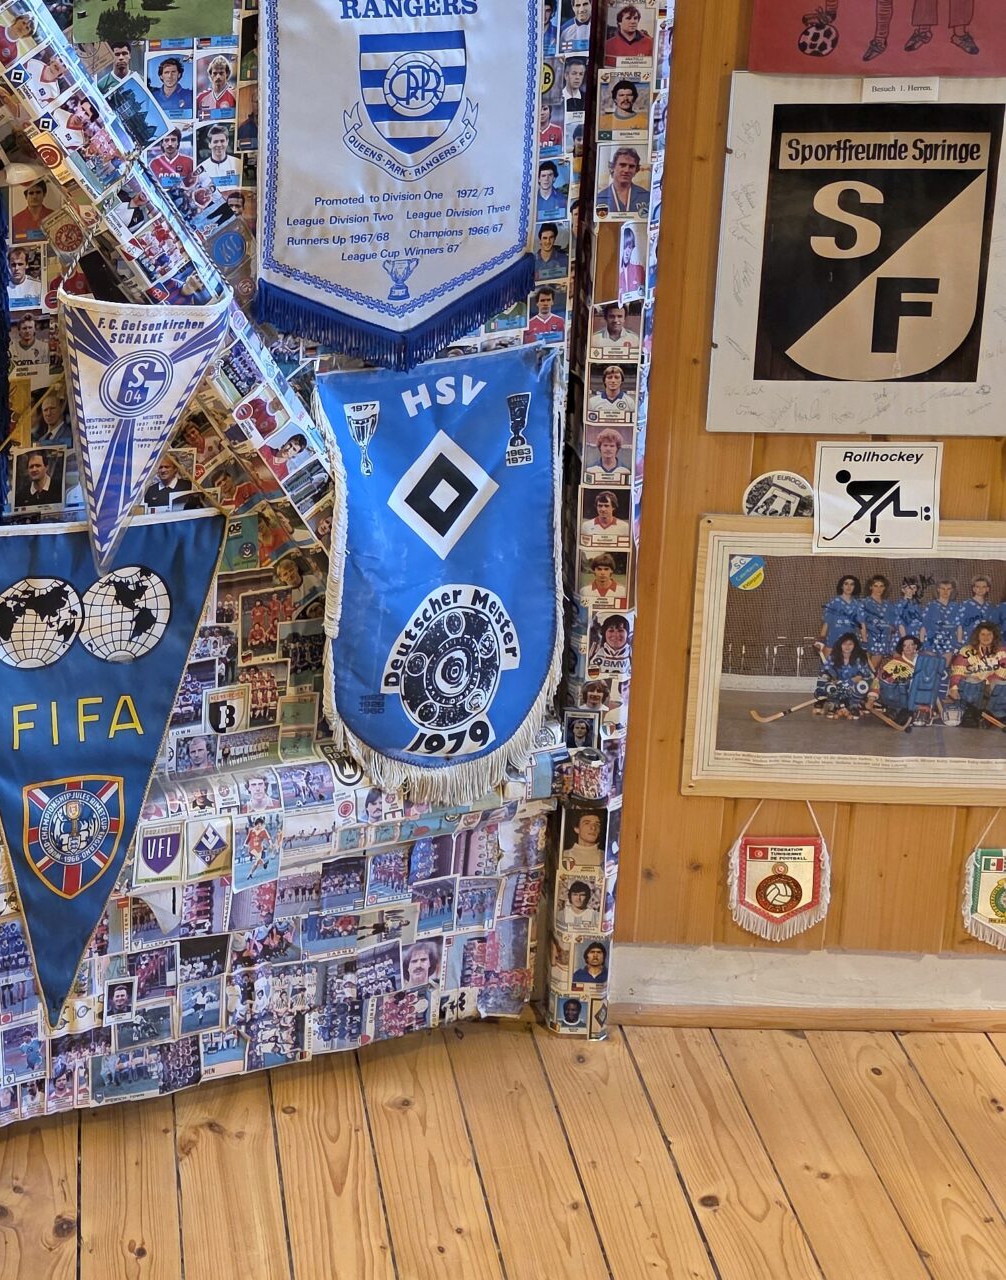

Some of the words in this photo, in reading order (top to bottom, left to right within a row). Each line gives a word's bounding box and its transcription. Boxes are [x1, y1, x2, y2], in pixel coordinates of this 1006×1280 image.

[787, 138, 908, 165] Sportfreunde
[912, 138, 981, 165] Springe
[314, 194, 364, 206] Promoted
[370, 194, 380, 203] to
[382, 191, 421, 202] Division
[424, 191, 444, 200] One
[456, 186, 494, 199] 1972/73
[287, 216, 325, 227] League
[329, 214, 369, 225] Division
[373, 212, 394, 222] Two
[406, 209, 442, 220] League
[445, 207, 483, 218] Division
[487, 204, 511, 215] Three
[287, 235, 329, 246] Runners
[332, 235, 346, 246] Up
[350, 232, 389, 244] 1967/68
[409, 227, 463, 239] Champions
[468, 223, 503, 236] 1966/67
[341, 250, 377, 262] League
[380, 249, 400, 260] Cup
[404, 246, 444, 257] Winners
[110, 333, 164, 345] SCHALKE
[173, 332, 187, 342] 04
[401, 374, 487, 417] HSV
[351, 403, 376, 412] 1977
[842, 451, 924, 465] Rollhockey
[776, 474, 807, 491] EUROCUP
[383, 587, 463, 688] Deutscher
[470, 588, 518, 659] Meister
[12, 695, 145, 750] FIFA
[410, 723, 490, 755] 1979
[41, 791, 72, 841] CHAMPIONSHIP
[147, 836, 173, 861] VFL
